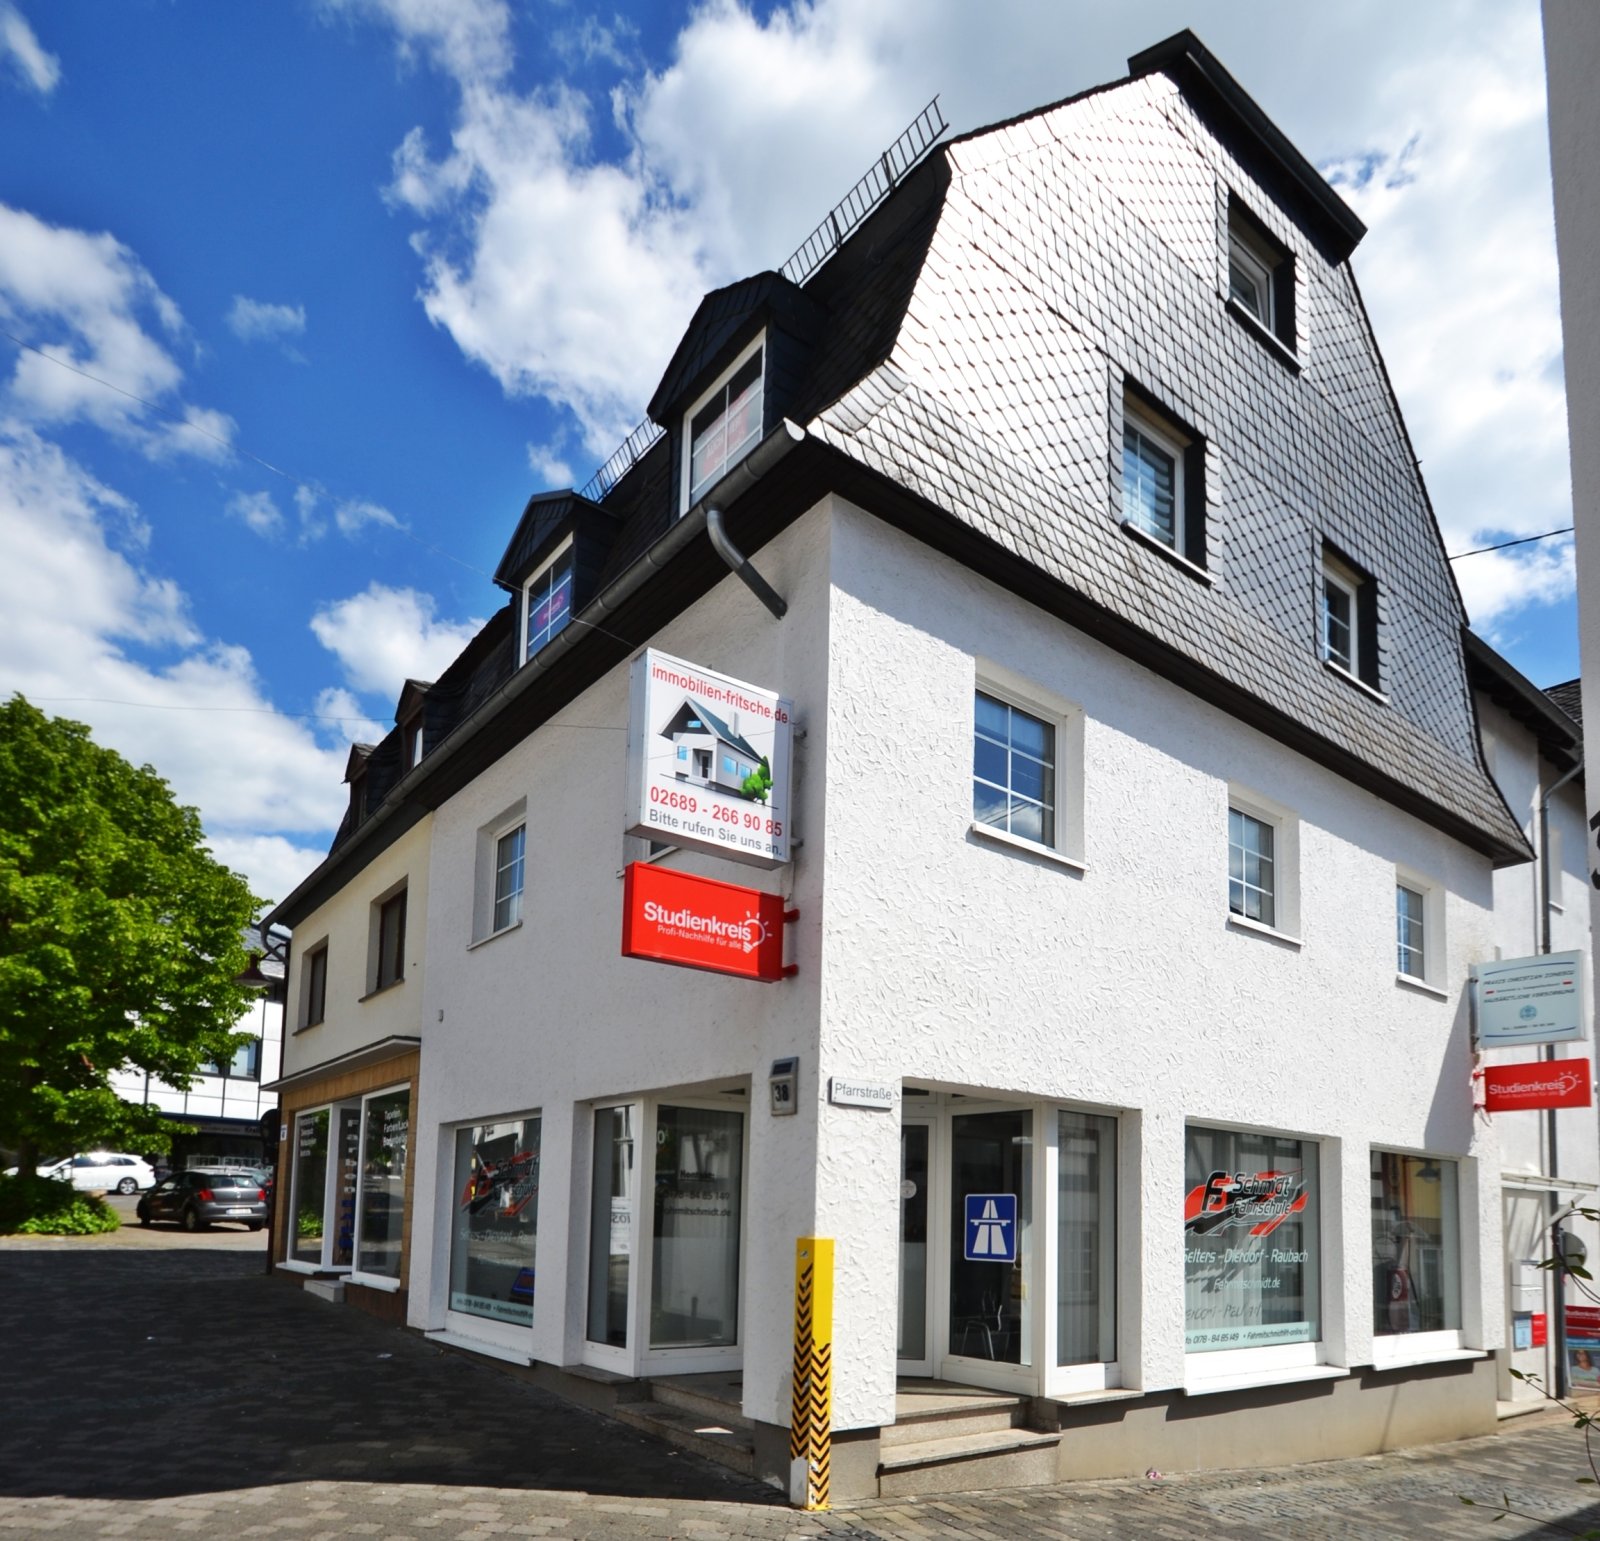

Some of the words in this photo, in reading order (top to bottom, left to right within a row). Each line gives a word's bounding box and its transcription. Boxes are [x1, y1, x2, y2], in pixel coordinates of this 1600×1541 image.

[652, 663, 788, 723] immobilien-fritsche.de
[650, 786, 697, 813] 02689
[712, 804, 739, 825] 266
[743, 813, 760, 831] 90
[765, 819, 783, 837] 85
[649, 808, 679, 827] Bitte
[683, 820, 714, 837] rufen
[718, 827, 737, 843] Sie
[741, 836, 761, 850] uns
[765, 842, 782, 856] an.
[643, 901, 752, 941] Studienkreis
[657, 924, 715, 945] Profi-Nachhilfe
[716, 936, 727, 947] für
[774, 1084, 789, 1102] 38
[834, 1082, 892, 1101] Pfarrstraße
[1488, 1080, 1566, 1095] Studienkreis
[1232, 1172, 1291, 1197] Schmidt
[1231, 1198, 1291, 1216] Fahrschule
[1184, 1247, 1217, 1264] Selters
[1224, 1248, 1265, 1264] Dierdorf
[1271, 1248, 1309, 1263] Raubach
